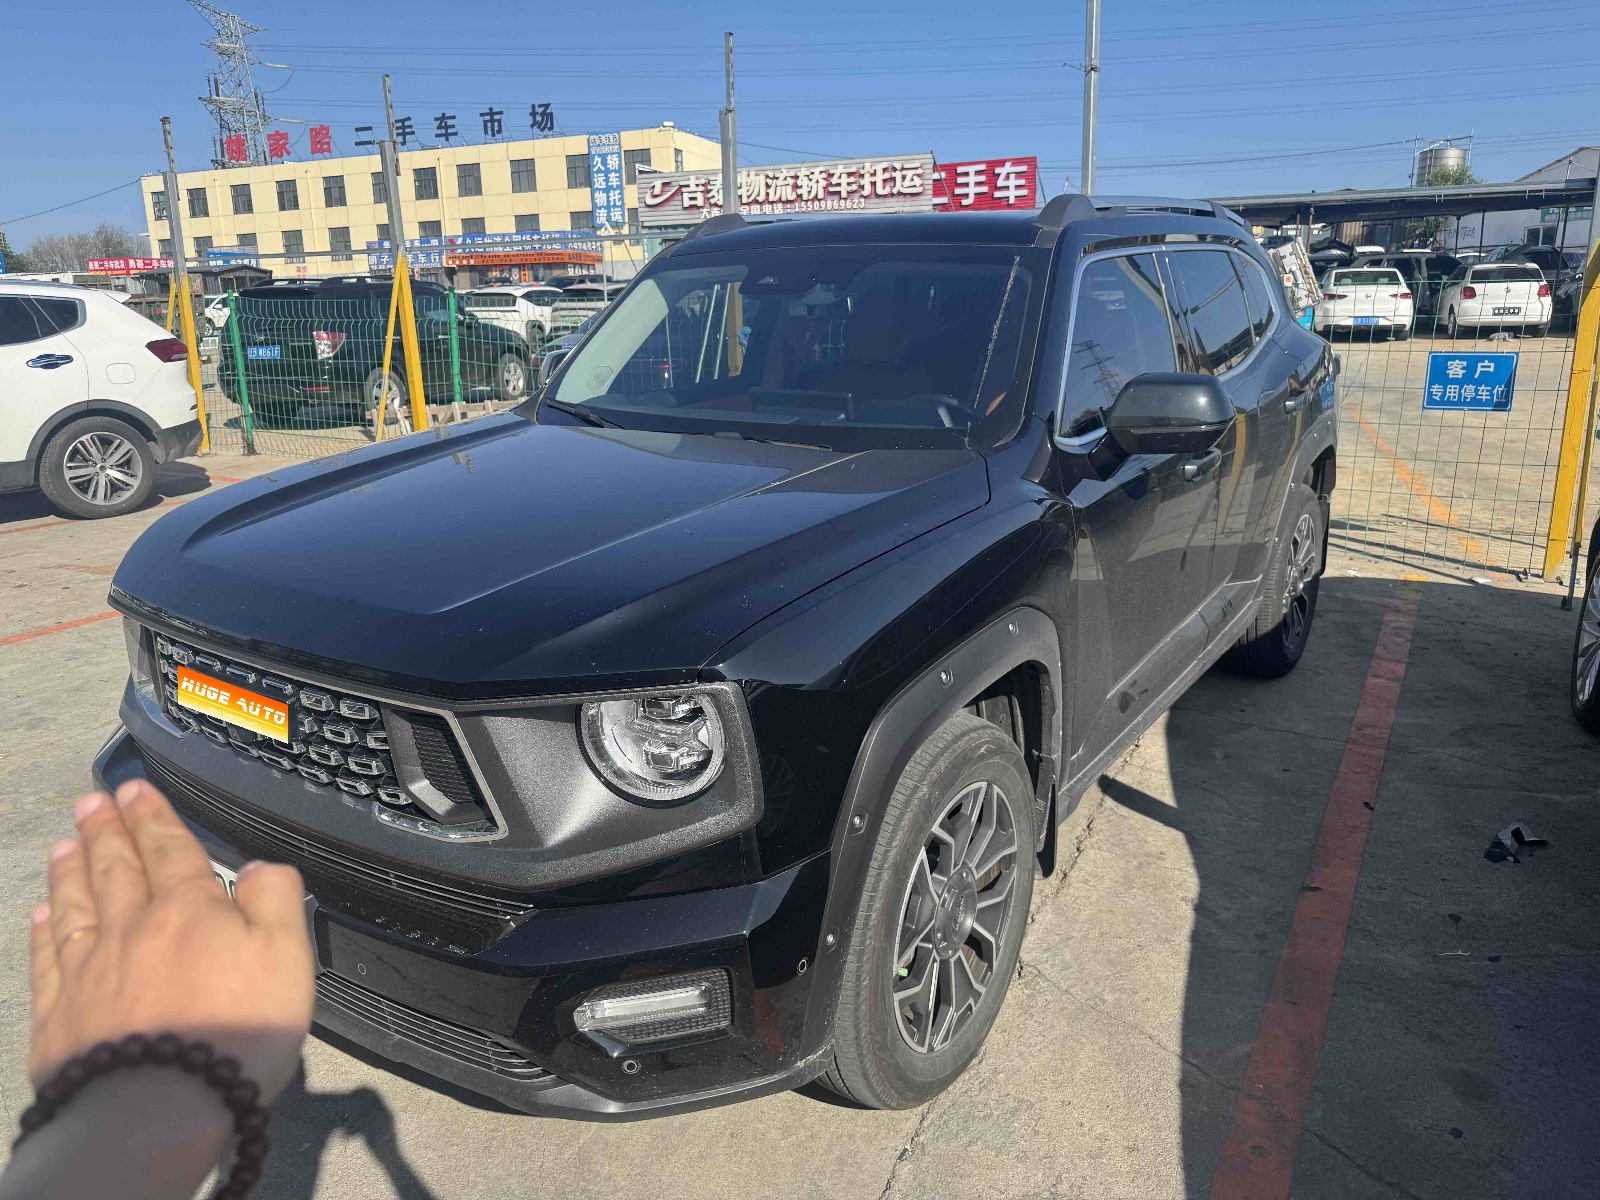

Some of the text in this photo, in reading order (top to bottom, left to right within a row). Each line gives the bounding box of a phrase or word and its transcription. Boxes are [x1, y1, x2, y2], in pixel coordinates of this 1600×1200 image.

[593, 155, 607, 224] 久远物流
[607, 154, 622, 222] 轿车托运
[368, 253, 439, 265] 明子手车行
[1430, 383, 1508, 403] 专用停车位
